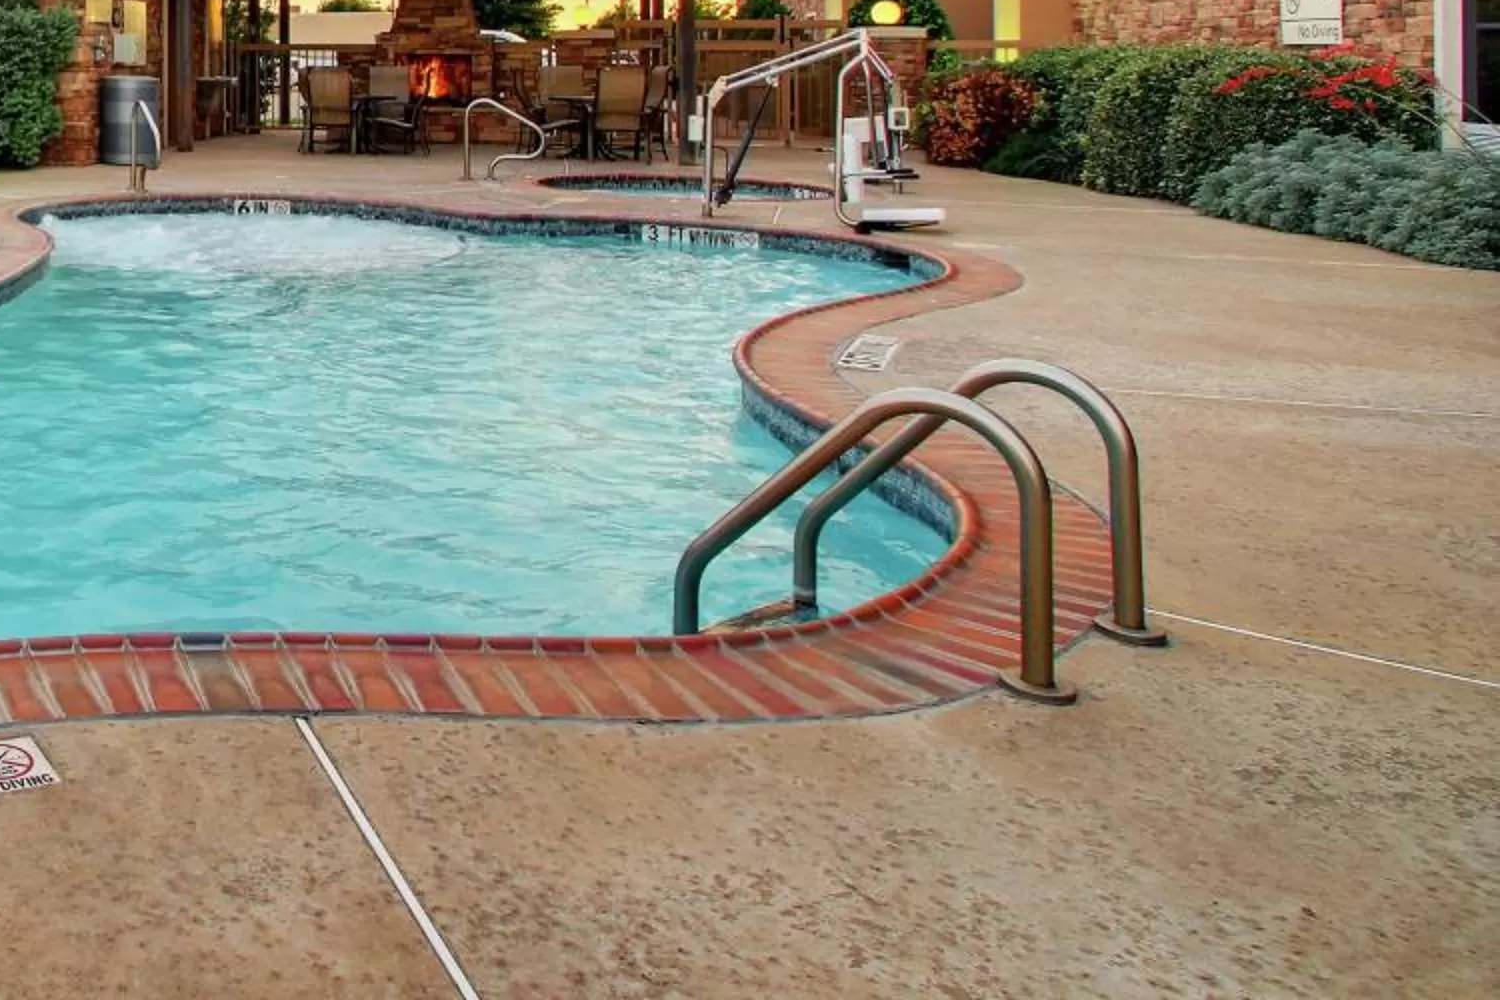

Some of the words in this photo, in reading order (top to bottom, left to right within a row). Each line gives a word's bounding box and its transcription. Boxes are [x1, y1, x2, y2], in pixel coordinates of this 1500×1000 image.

[1300, 25, 1310, 38] No
[1312, 23, 1338, 40] Diving
[238, 201, 250, 214] 6
[648, 225, 658, 240] 3
[0, 773, 53, 791] DIVING
